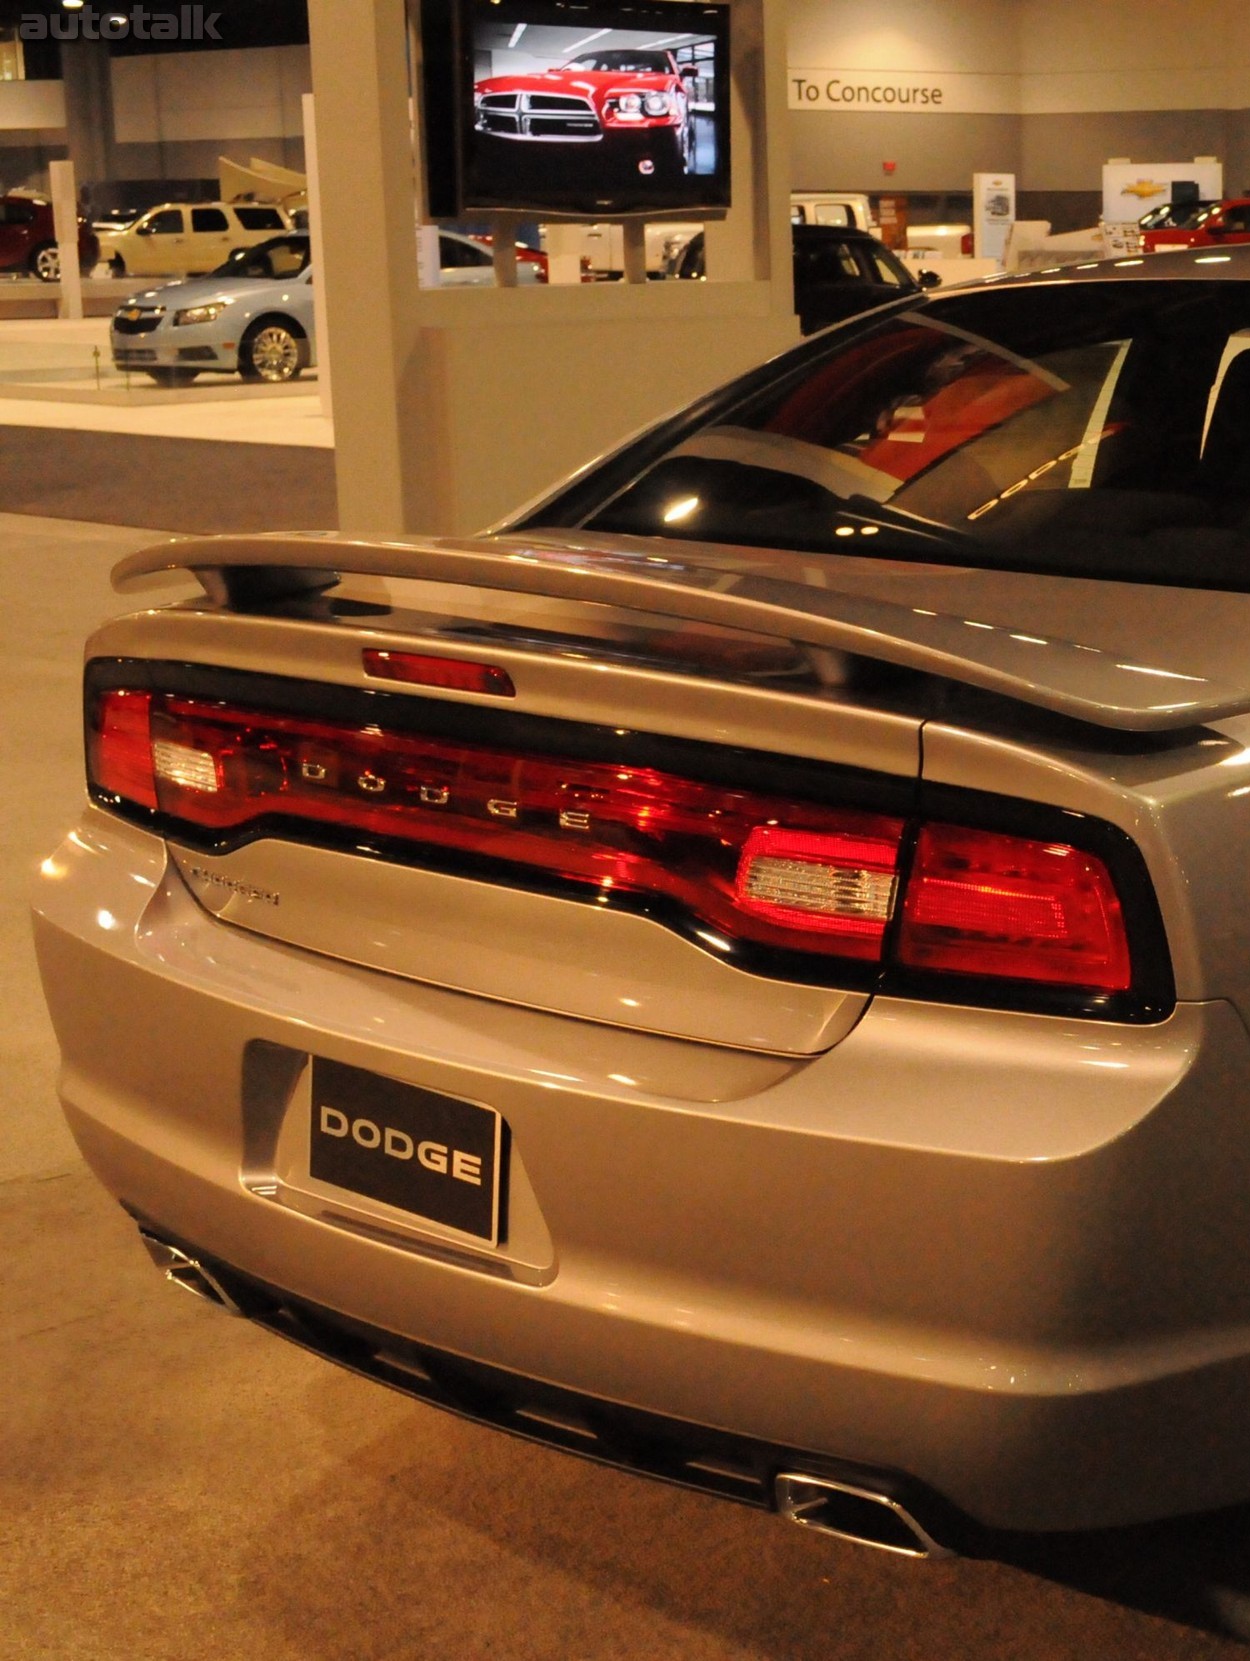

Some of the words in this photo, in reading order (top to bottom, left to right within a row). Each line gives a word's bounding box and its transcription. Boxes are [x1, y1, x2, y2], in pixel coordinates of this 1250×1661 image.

[792, 79, 820, 101] To
[826, 80, 943, 104] Concourse
[302, 763, 590, 831] DODGE
[320, 1105, 482, 1186] DODGE
